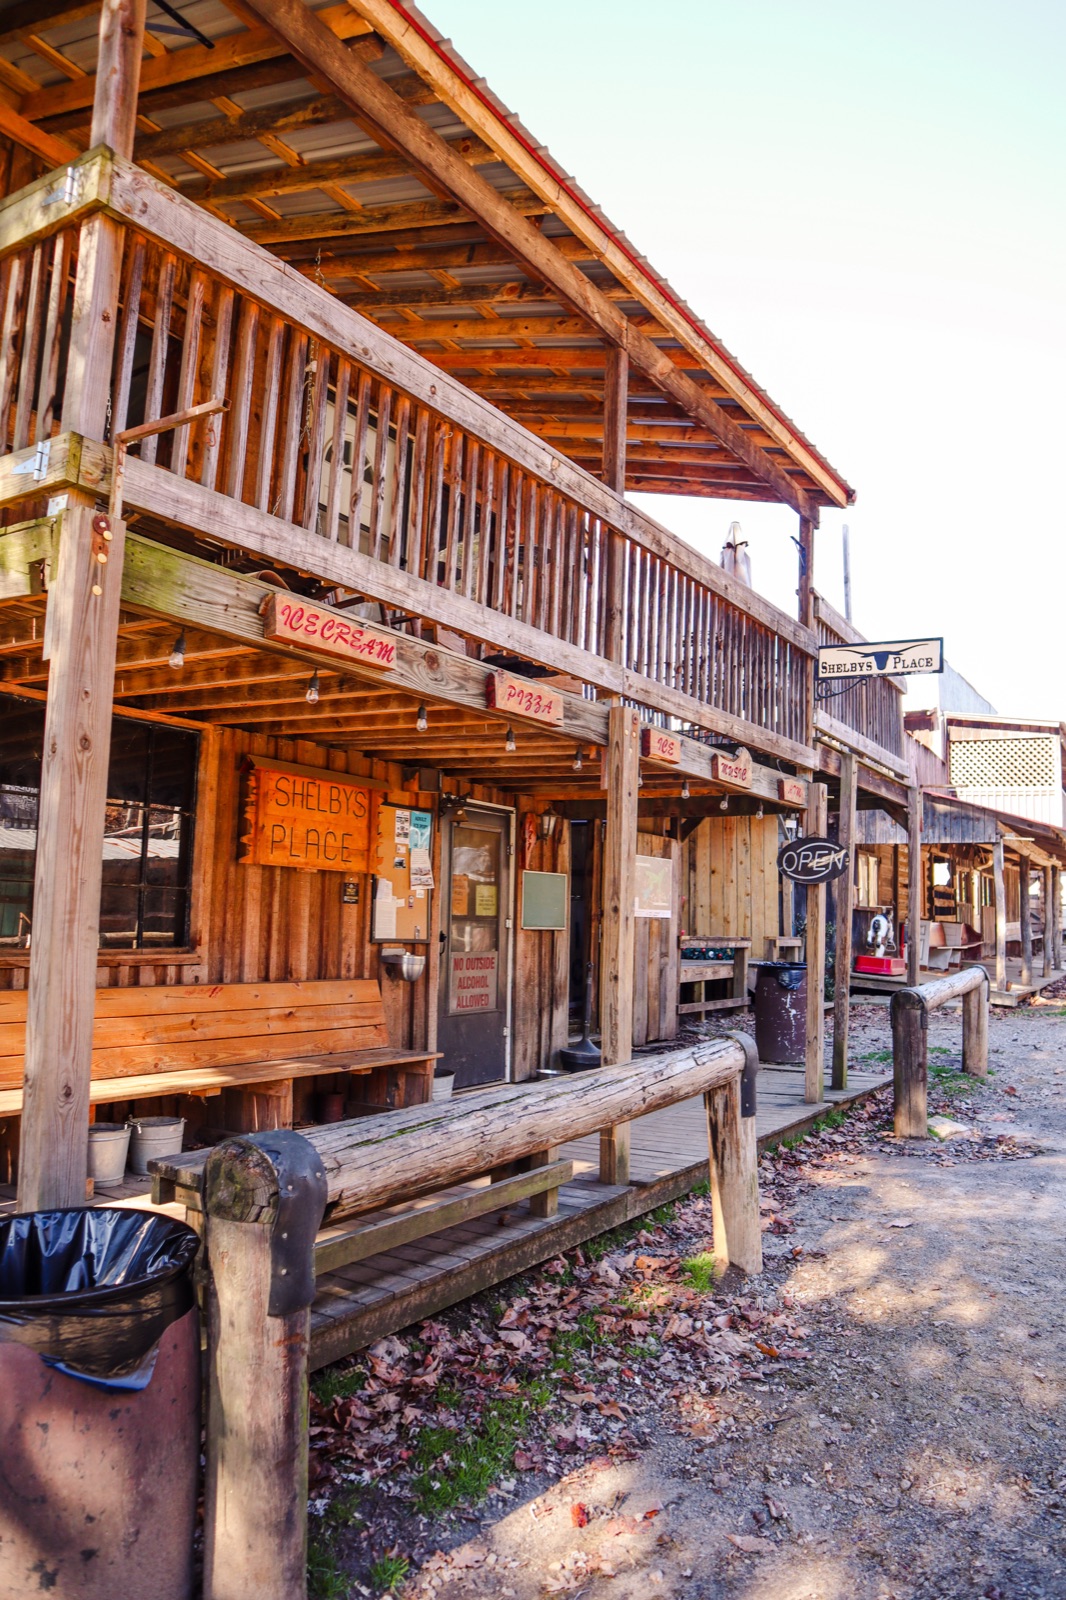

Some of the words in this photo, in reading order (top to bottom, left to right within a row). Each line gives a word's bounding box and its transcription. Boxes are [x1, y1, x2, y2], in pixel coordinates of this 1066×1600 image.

[821, 661, 873, 674] SHELBYS
[893, 656, 933, 669] PLACE
[507, 685, 553, 714] PIZZA
[657, 738, 675, 756] ICE
[721, 762, 748, 781] MUSIC
[270, 824, 353, 863] PLACE
[783, 850, 846, 871] OPEN
[453, 957, 464, 971] NO
[466, 957, 495, 970] OUTSIDE
[458, 975, 489, 989] ALCOHOL
[456, 993, 489, 1009] ALLOWED
